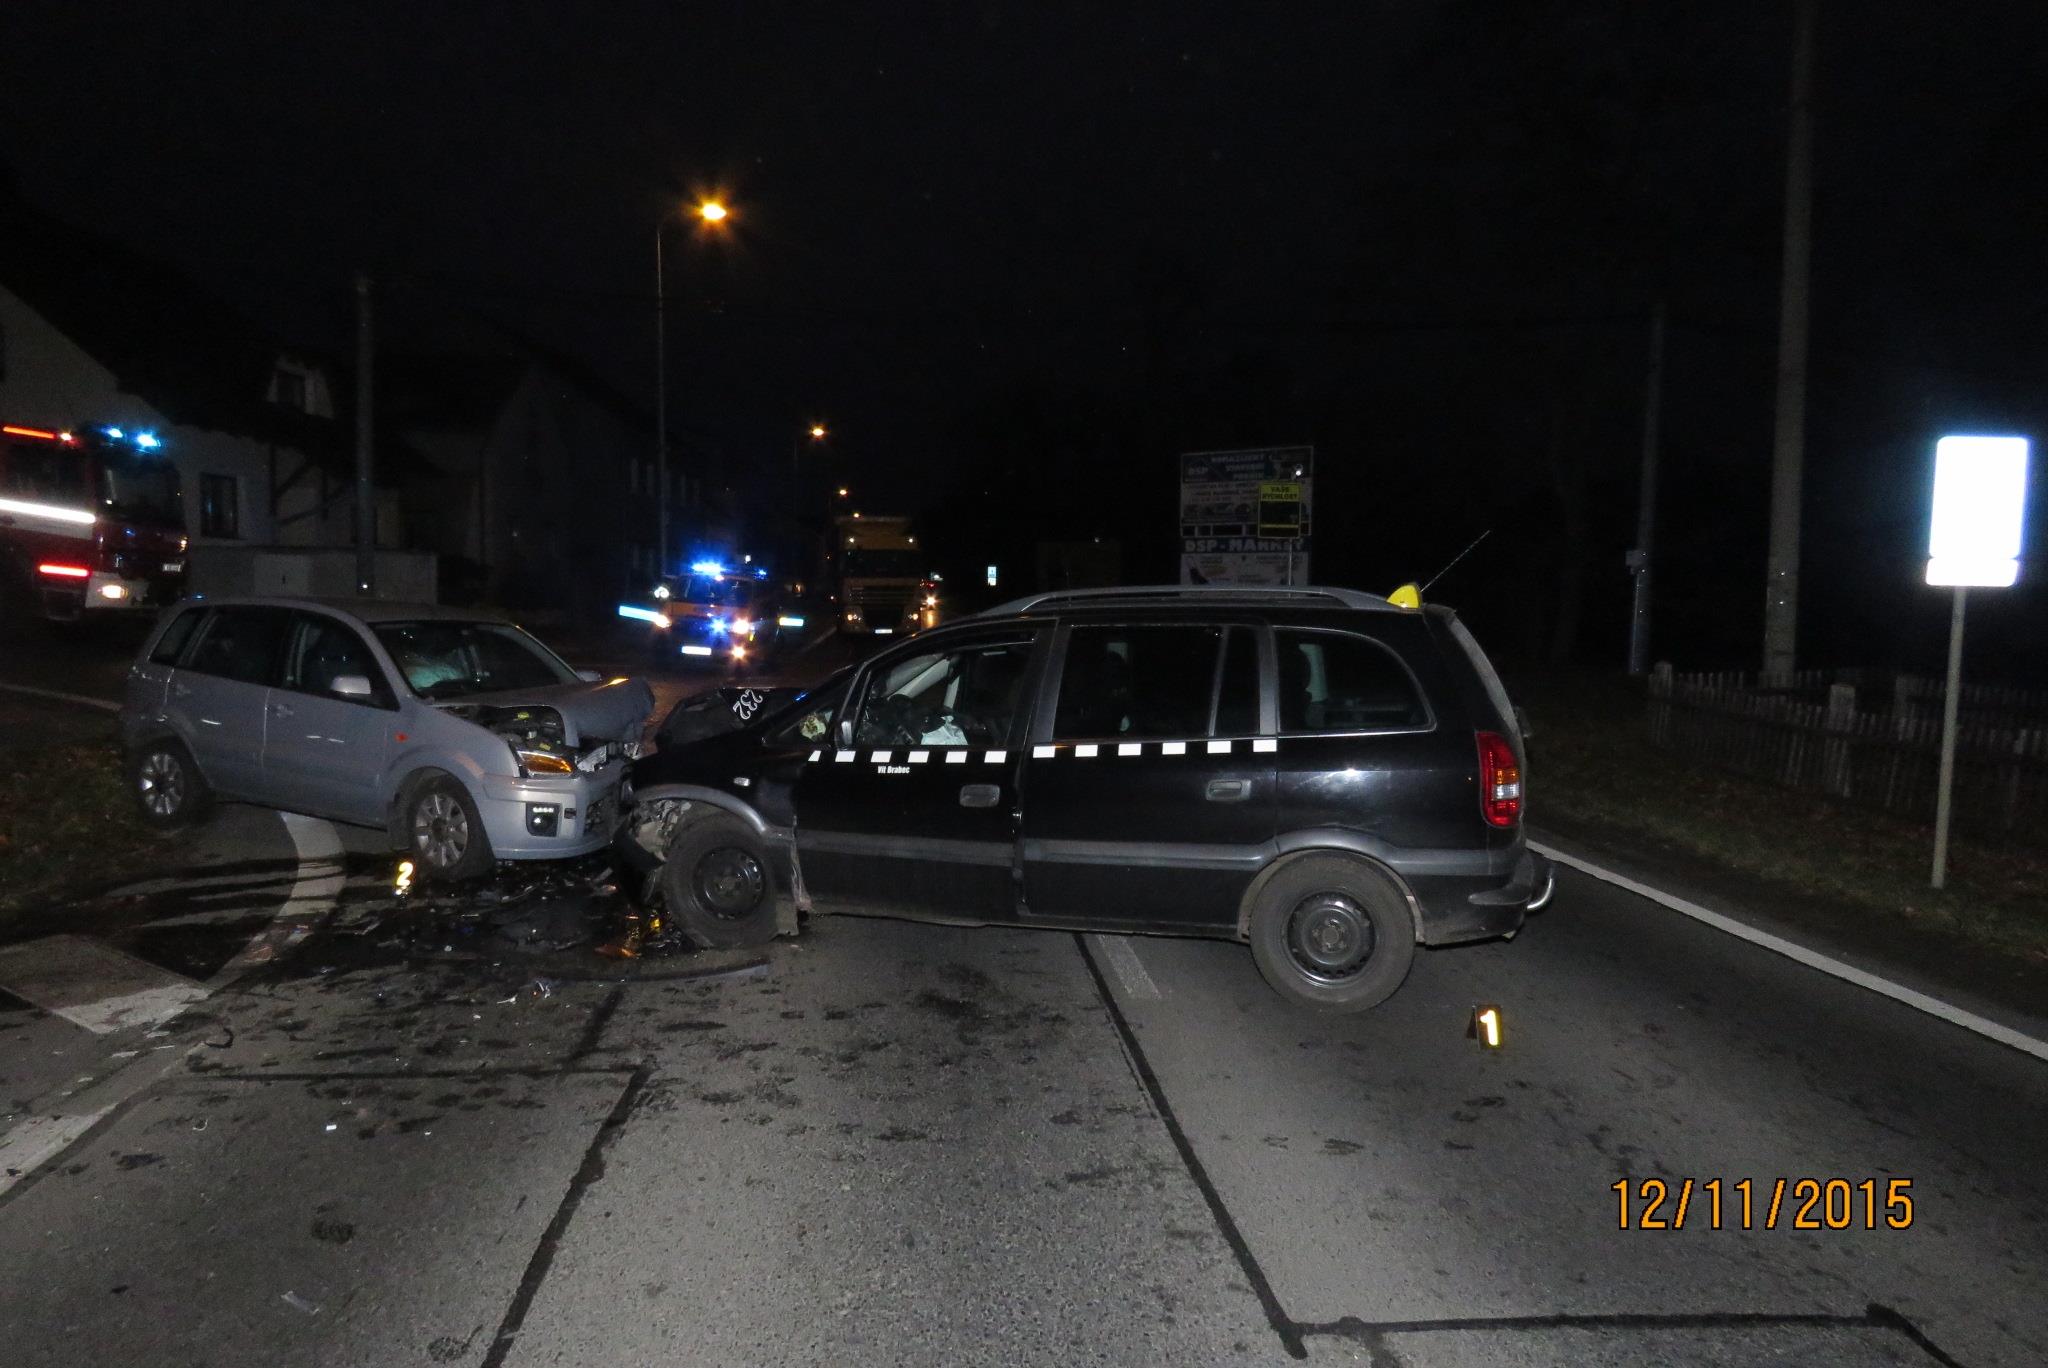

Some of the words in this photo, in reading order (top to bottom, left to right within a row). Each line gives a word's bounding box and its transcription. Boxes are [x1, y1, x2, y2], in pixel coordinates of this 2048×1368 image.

[732, 688, 764, 720] 232
[396, 861, 414, 887] 2
[1479, 1009, 1499, 1046] 1
